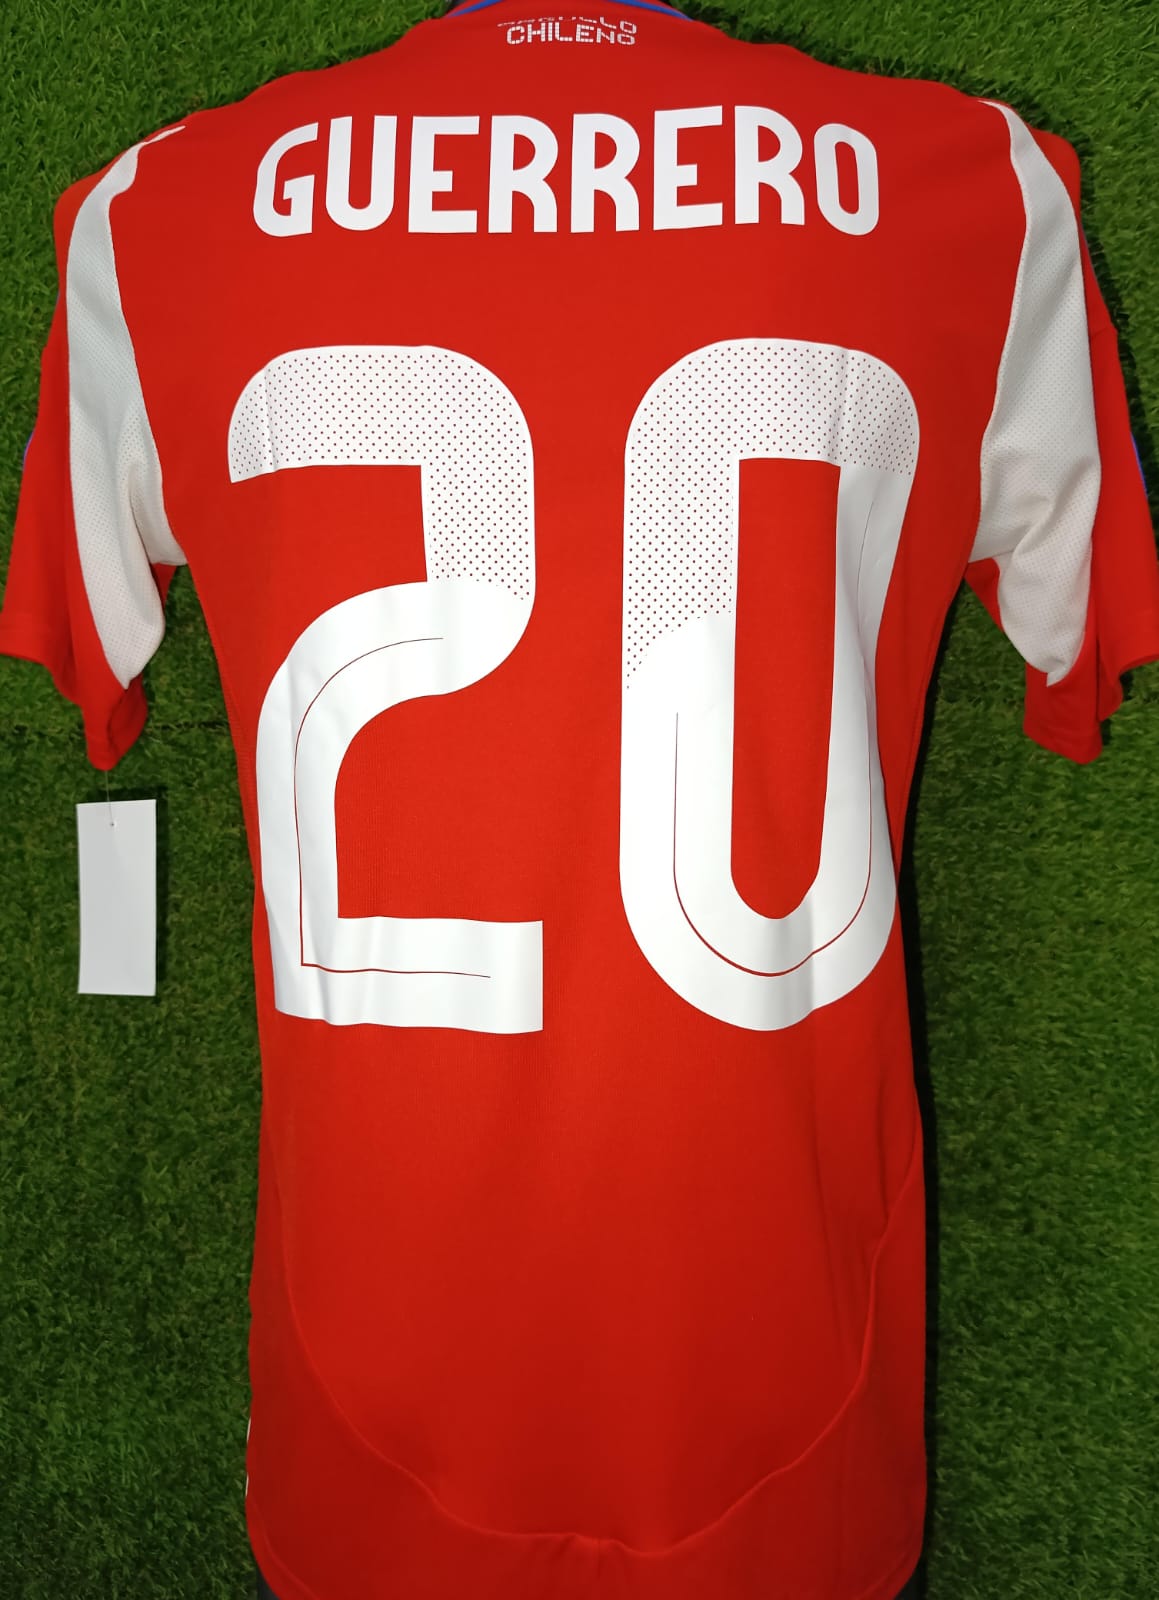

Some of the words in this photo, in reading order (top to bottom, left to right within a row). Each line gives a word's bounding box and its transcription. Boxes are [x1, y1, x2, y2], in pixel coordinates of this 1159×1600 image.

[506, 21, 636, 46] CHILENO
[252, 105, 880, 238] GUERRERO
[227, 337, 920, 1035] 20
